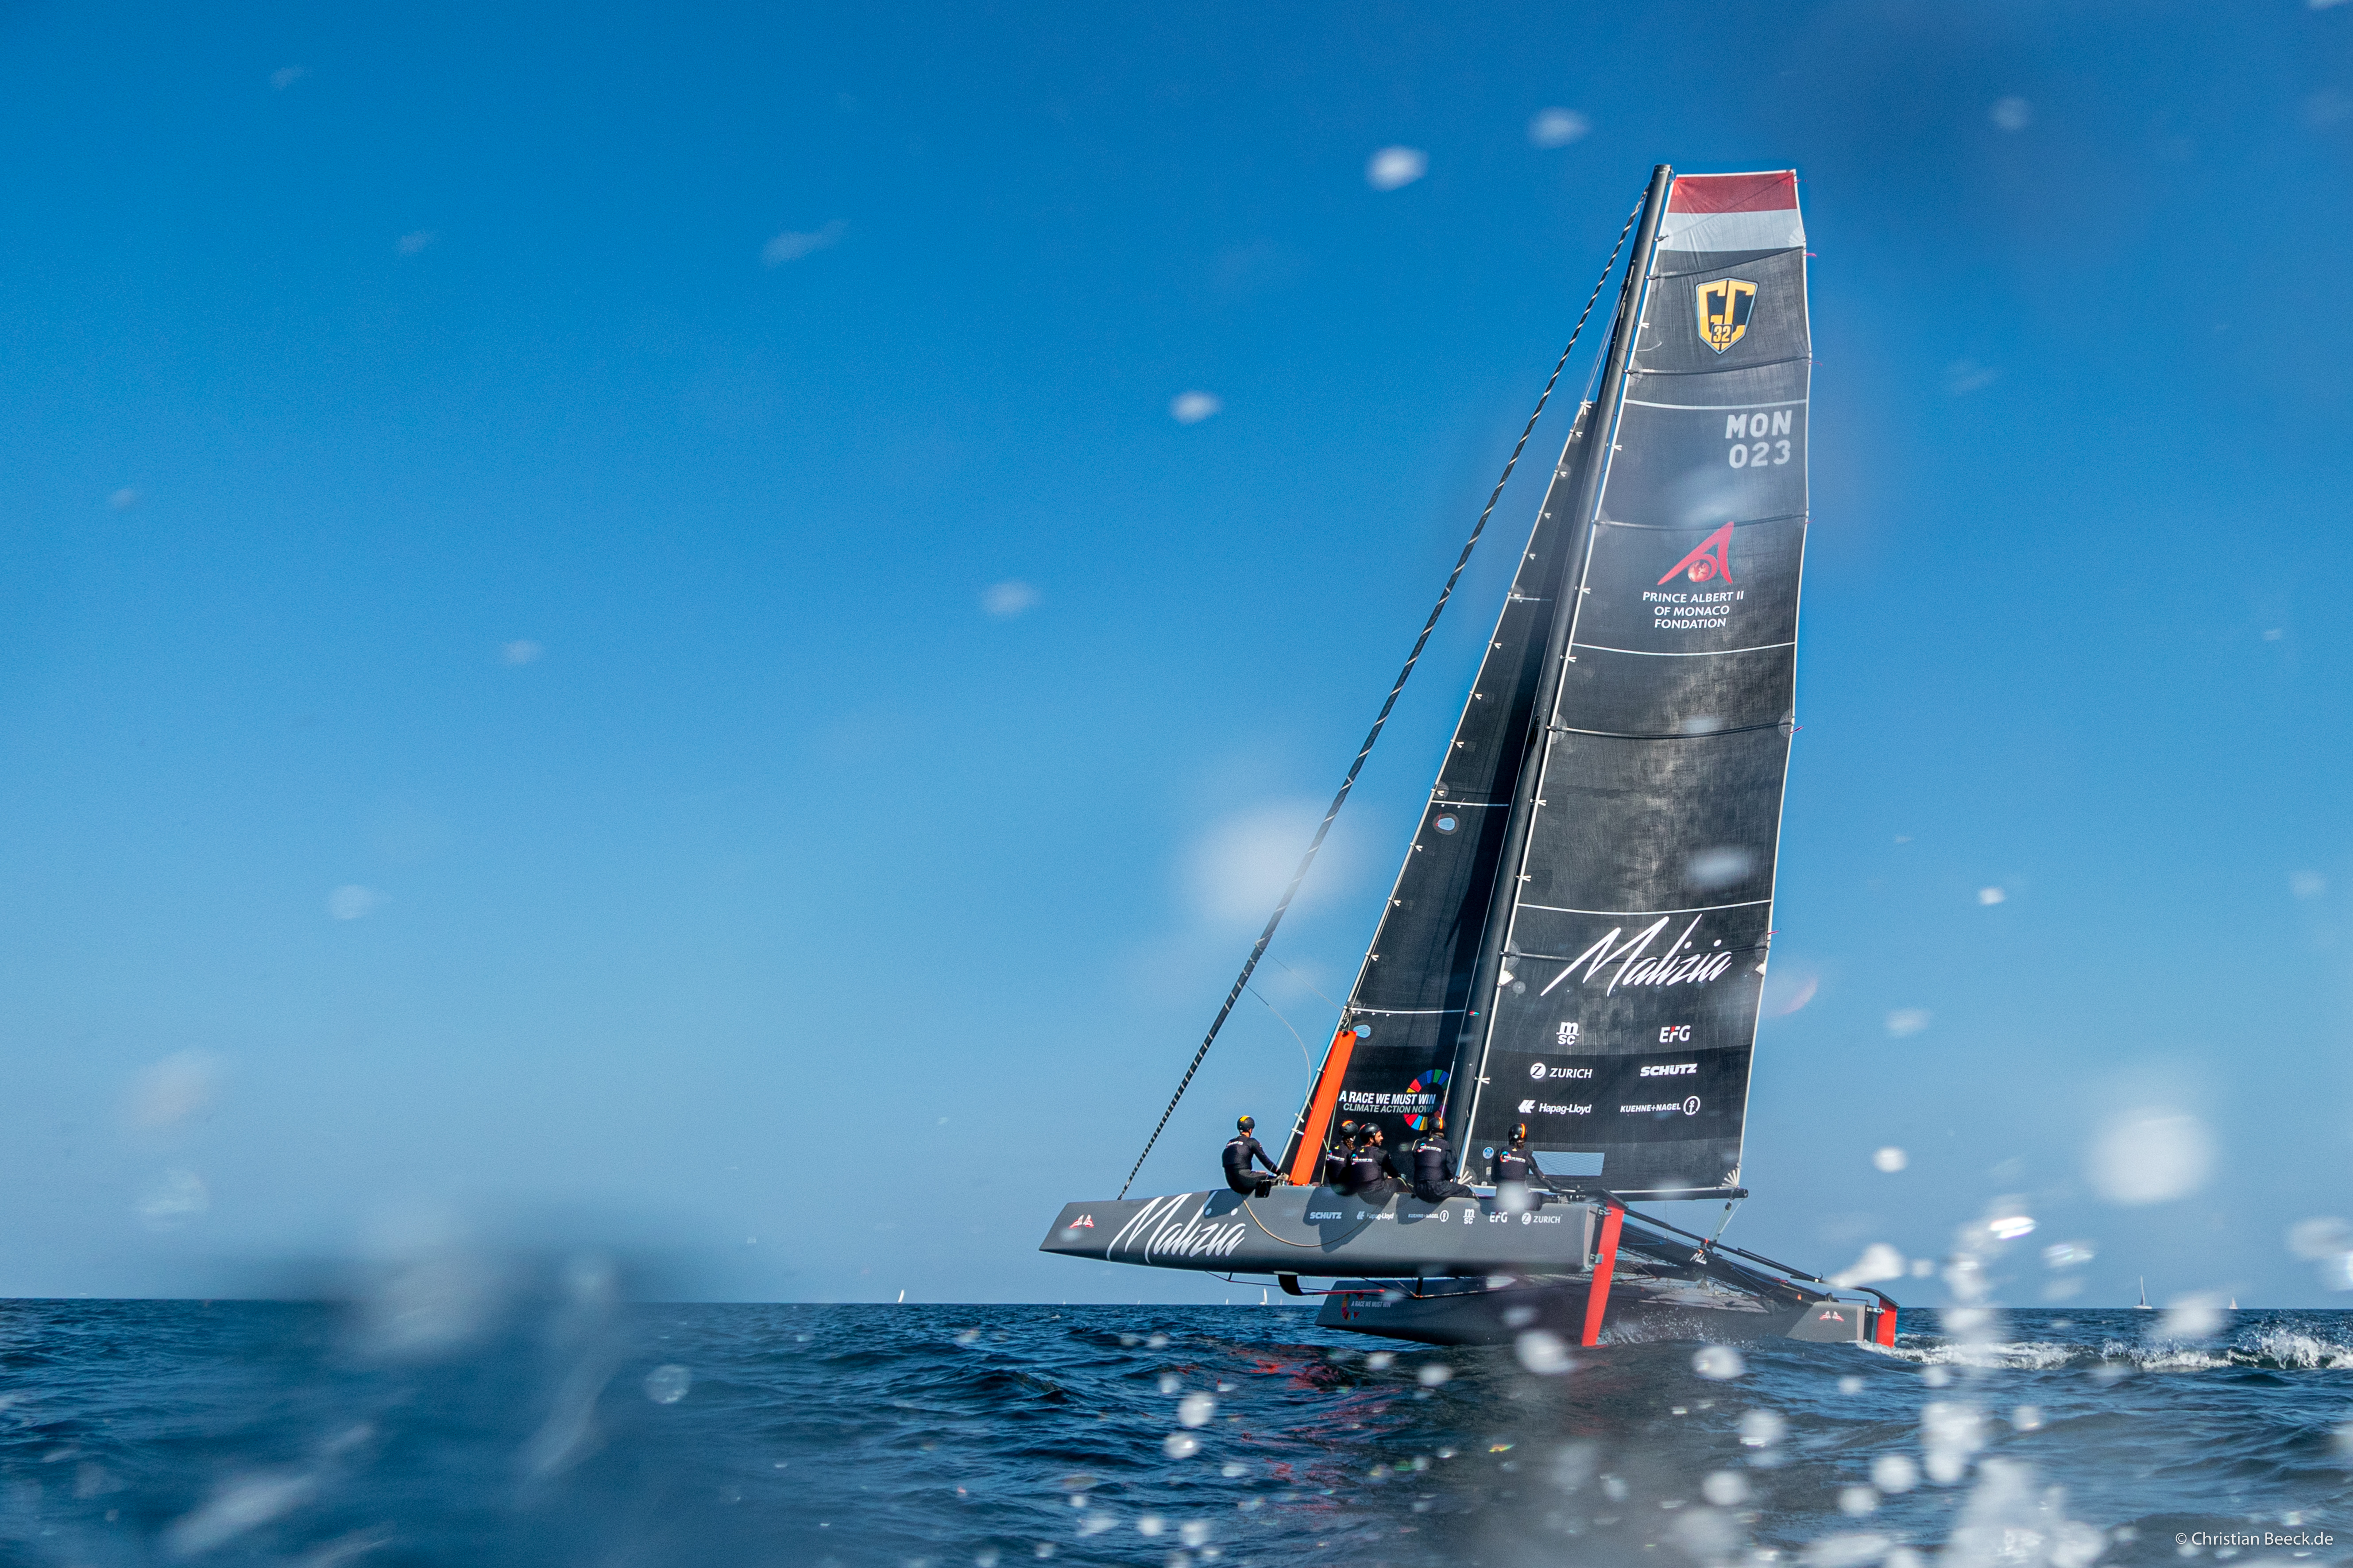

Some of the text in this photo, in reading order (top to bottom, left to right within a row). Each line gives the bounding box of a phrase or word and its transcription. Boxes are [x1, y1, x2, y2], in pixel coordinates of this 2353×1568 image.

[1713, 325, 1731, 342] 32
[1725, 410, 1792, 439] MON
[1729, 440, 1791, 469] 023
[1643, 591, 1744, 603] PRINCE ALBERT II
[1654, 605, 1730, 616] OF MONACO
[1654, 618, 1726, 629] FONDATION
[1540, 913, 1732, 997] Malizia
[1659, 1025, 1691, 1043] EFG
[1549, 1068, 1593, 1078] ZURICH
[1338, 1090, 1436, 1105] A RACE WE MUST WIN
[1343, 1103, 1380, 1112] CLIMATE
[1380, 1105, 1411, 1113] ACTION
[1539, 1103, 1592, 1115] Hapag-Lloyd
[1620, 1103, 1681, 1112] KUEHNE+NAGEL
[1489, 1212, 1508, 1223] EFG
[1106, 1190, 1246, 1264] Malizia
